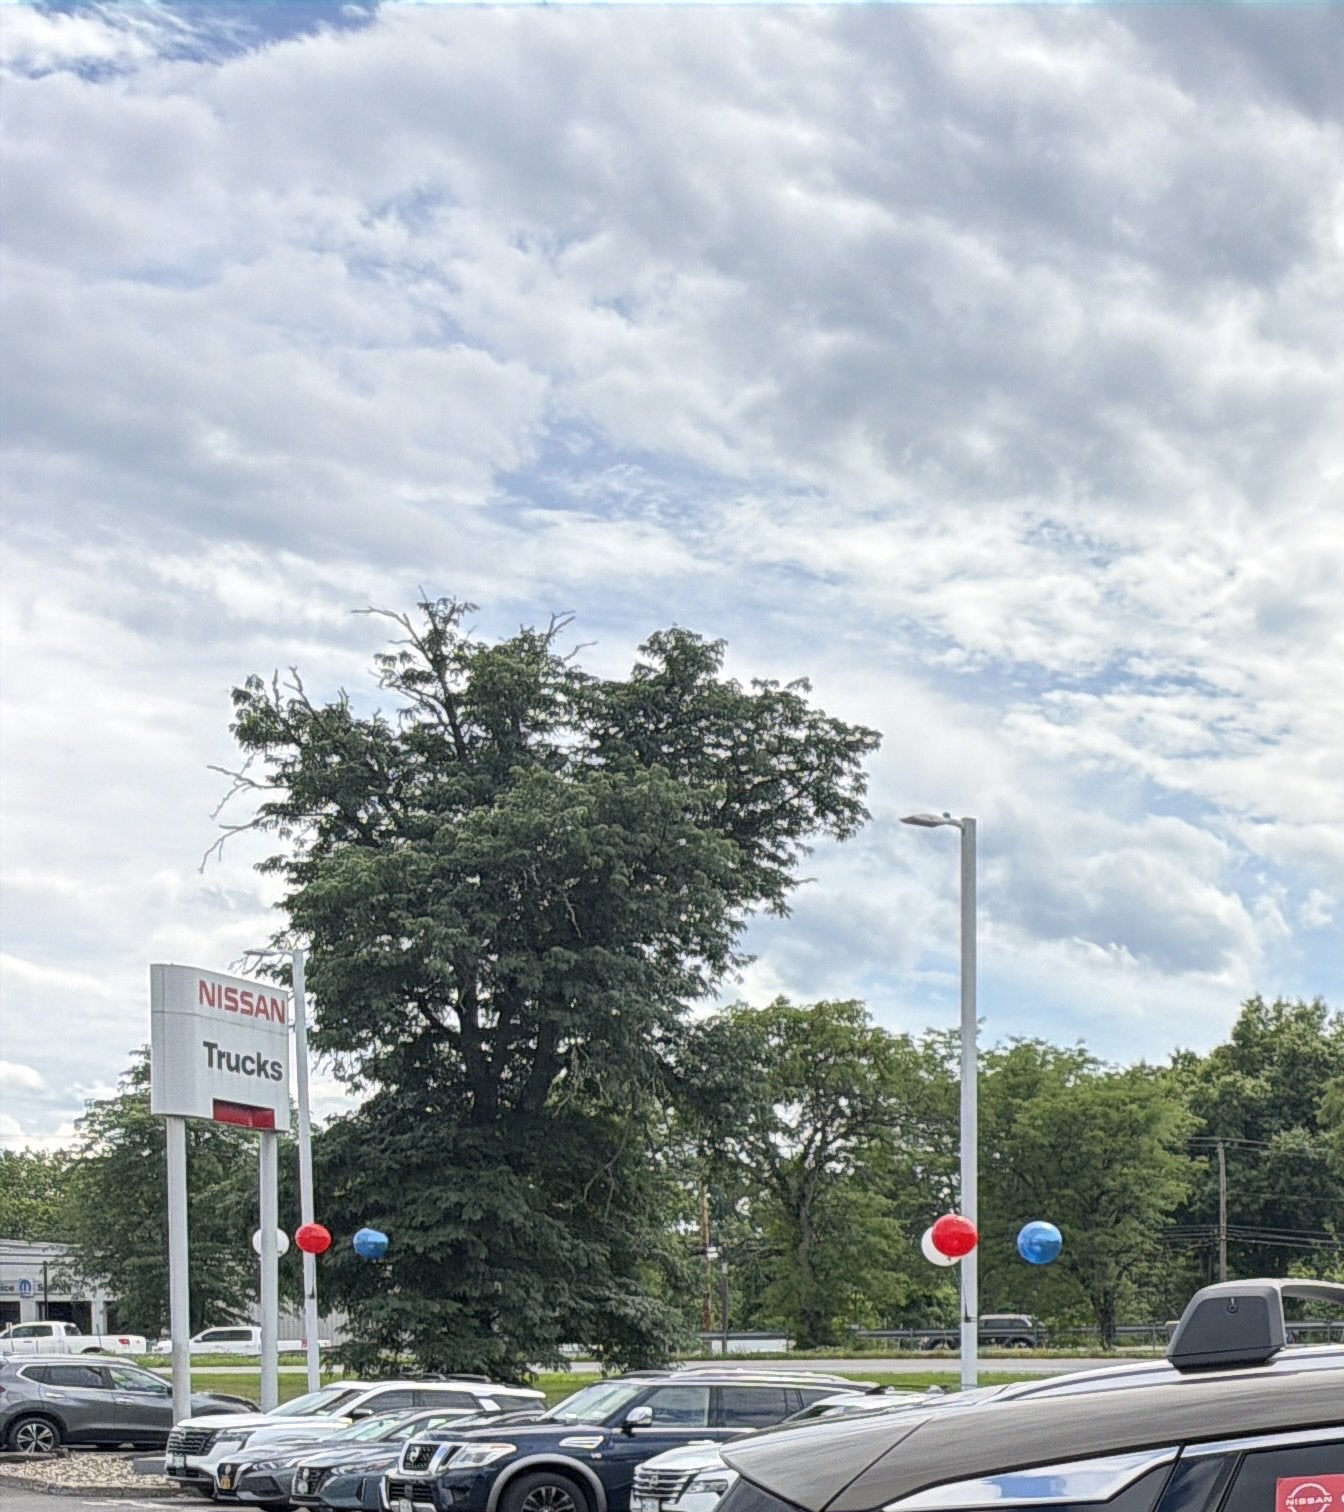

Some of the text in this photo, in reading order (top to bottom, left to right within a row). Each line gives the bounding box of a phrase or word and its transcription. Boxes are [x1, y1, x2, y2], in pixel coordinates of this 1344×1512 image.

[199, 980, 286, 1024] NISSAN
[202, 1040, 283, 1082] Trucks
[1285, 1495, 1333, 1506] NISSAN
